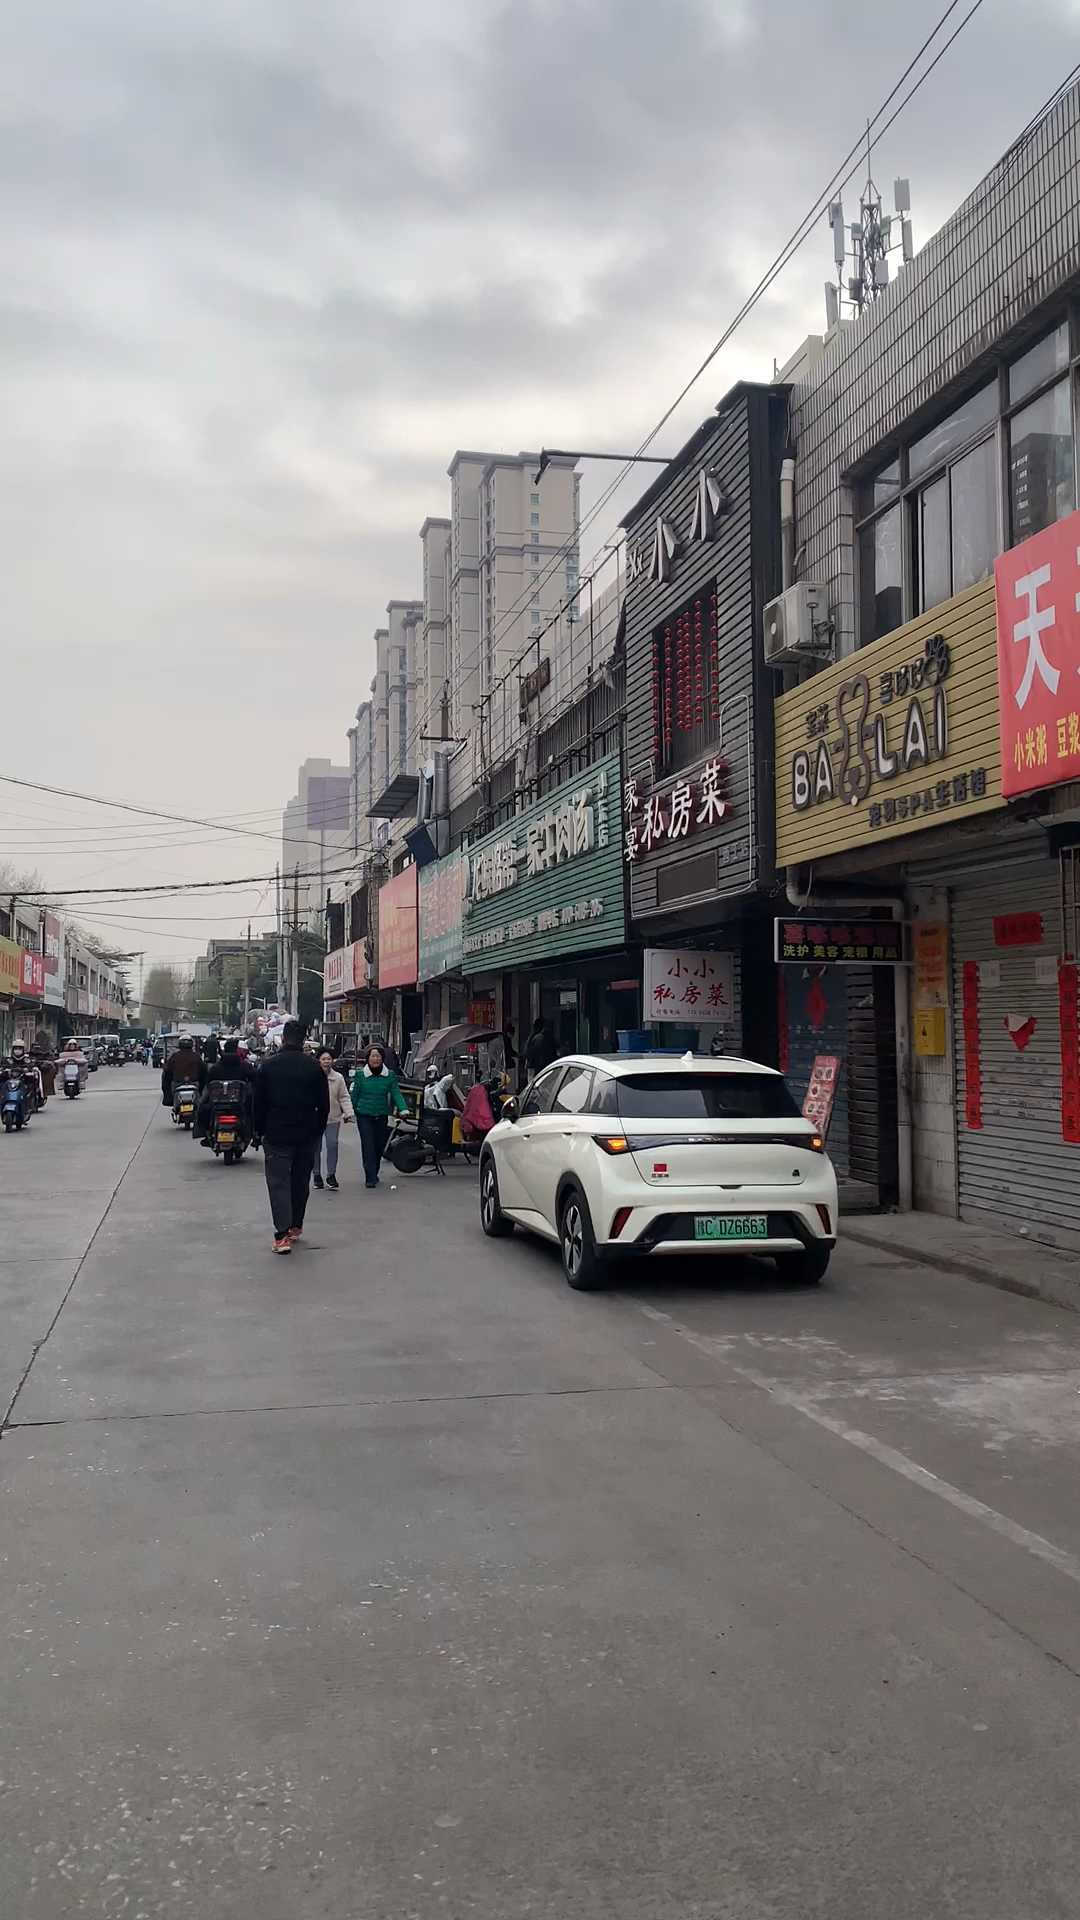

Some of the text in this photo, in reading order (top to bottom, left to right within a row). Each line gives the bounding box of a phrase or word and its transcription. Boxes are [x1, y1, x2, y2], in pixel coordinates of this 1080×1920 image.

[647, 469, 726, 583] 小小
[1013, 545, 1080, 711] 天
[1013, 723, 1048, 772] 小米粥
[623, 778, 641, 862] 家宴
[640, 758, 730, 851] 私房菜
[868, 767, 987, 828] 宠物SPA生活馆
[667, 957, 715, 979] 小小
[783, 944, 898, 959] 洗护 美容 宠粮 用品
[653, 980, 729, 1007] 私房菜
[719, 1218, 766, 1235] DZ6663
